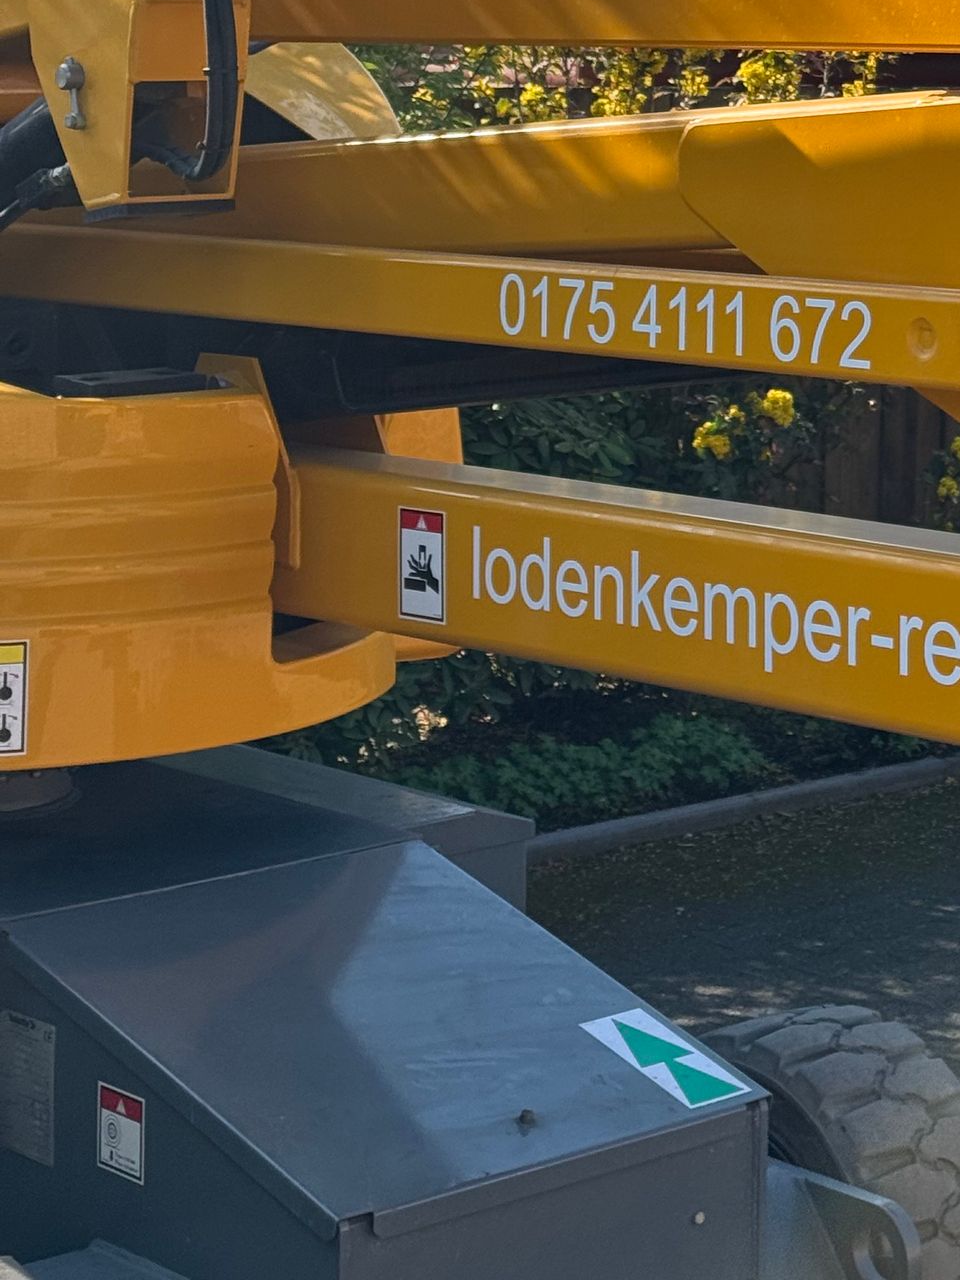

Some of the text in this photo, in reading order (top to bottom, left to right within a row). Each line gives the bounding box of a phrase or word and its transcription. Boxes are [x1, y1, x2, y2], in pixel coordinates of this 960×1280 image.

[499, 272, 873, 370] 0175 4111 672
